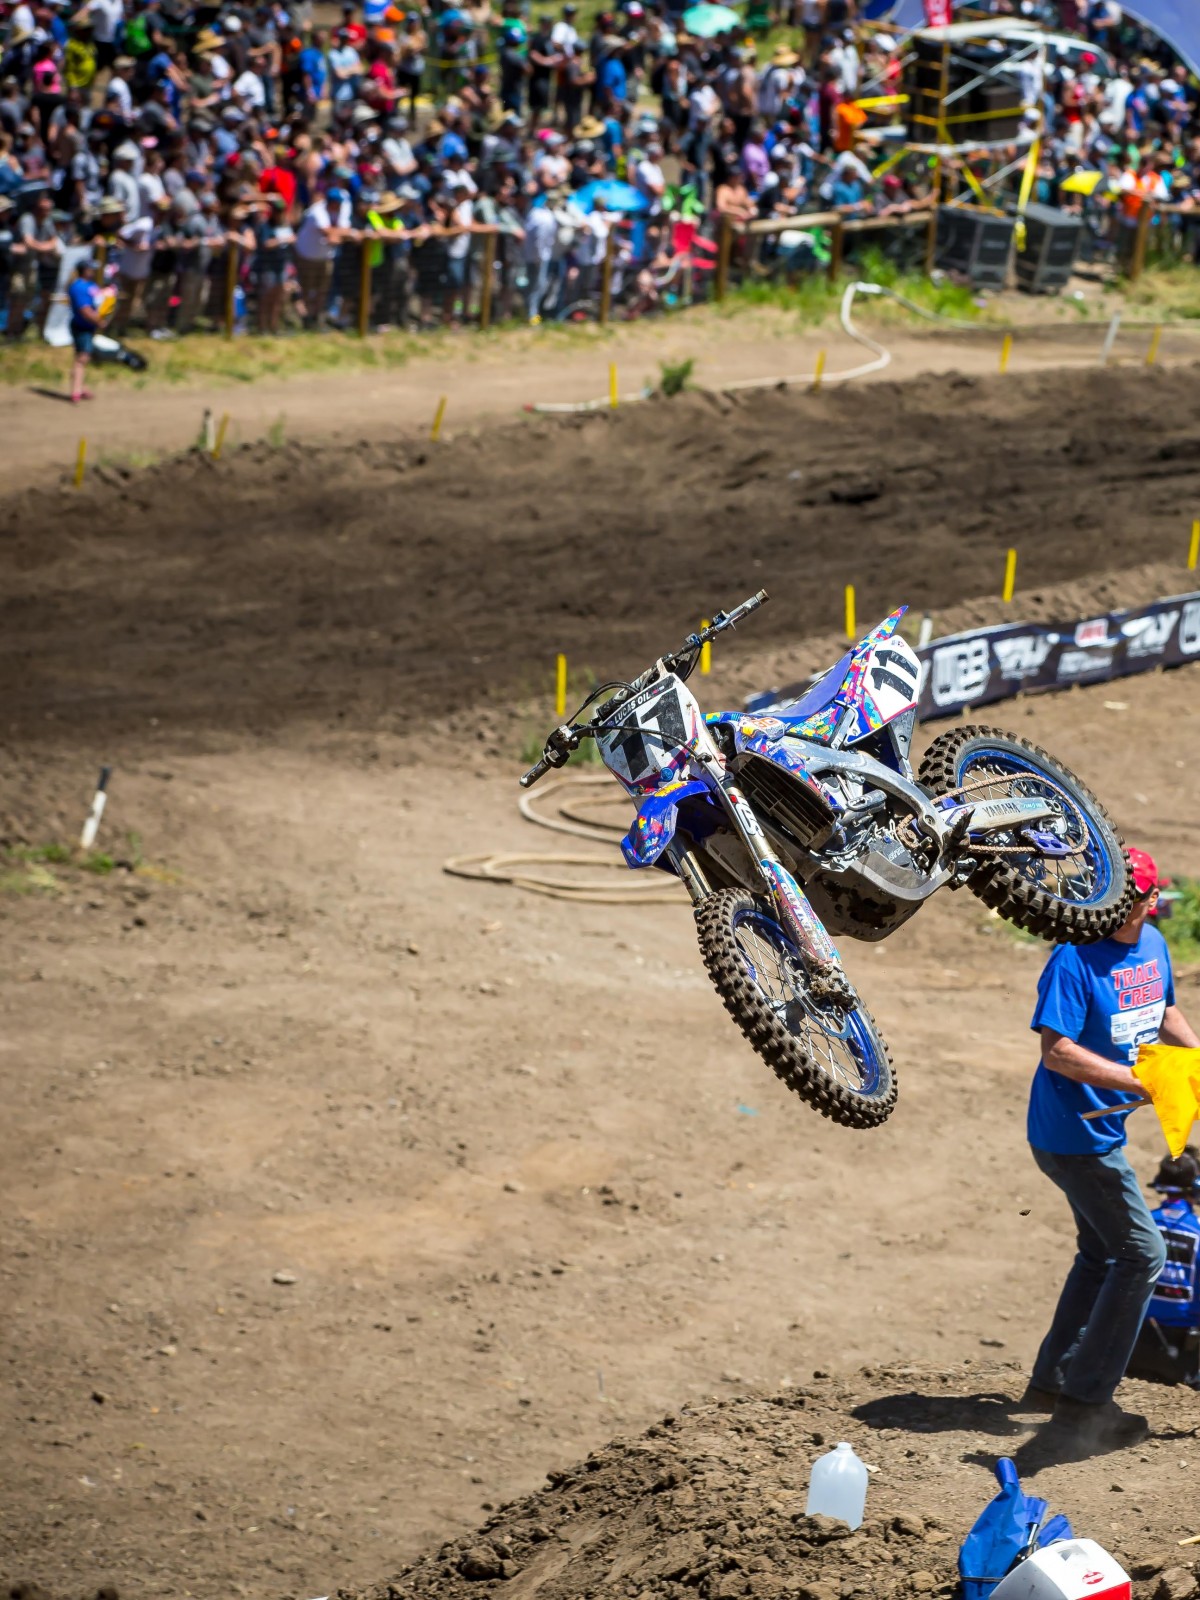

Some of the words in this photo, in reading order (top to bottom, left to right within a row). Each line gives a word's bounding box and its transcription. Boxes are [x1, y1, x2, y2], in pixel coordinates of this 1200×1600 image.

[871, 649, 918, 702] 11
[614, 701, 636, 723] LUCAS
[637, 691, 651, 705] OIL
[609, 688, 688, 781] 11
[982, 802, 1021, 818] YAMAHA
[1112, 960, 1161, 990] TRACK
[1119, 981, 1163, 1010] CREW
